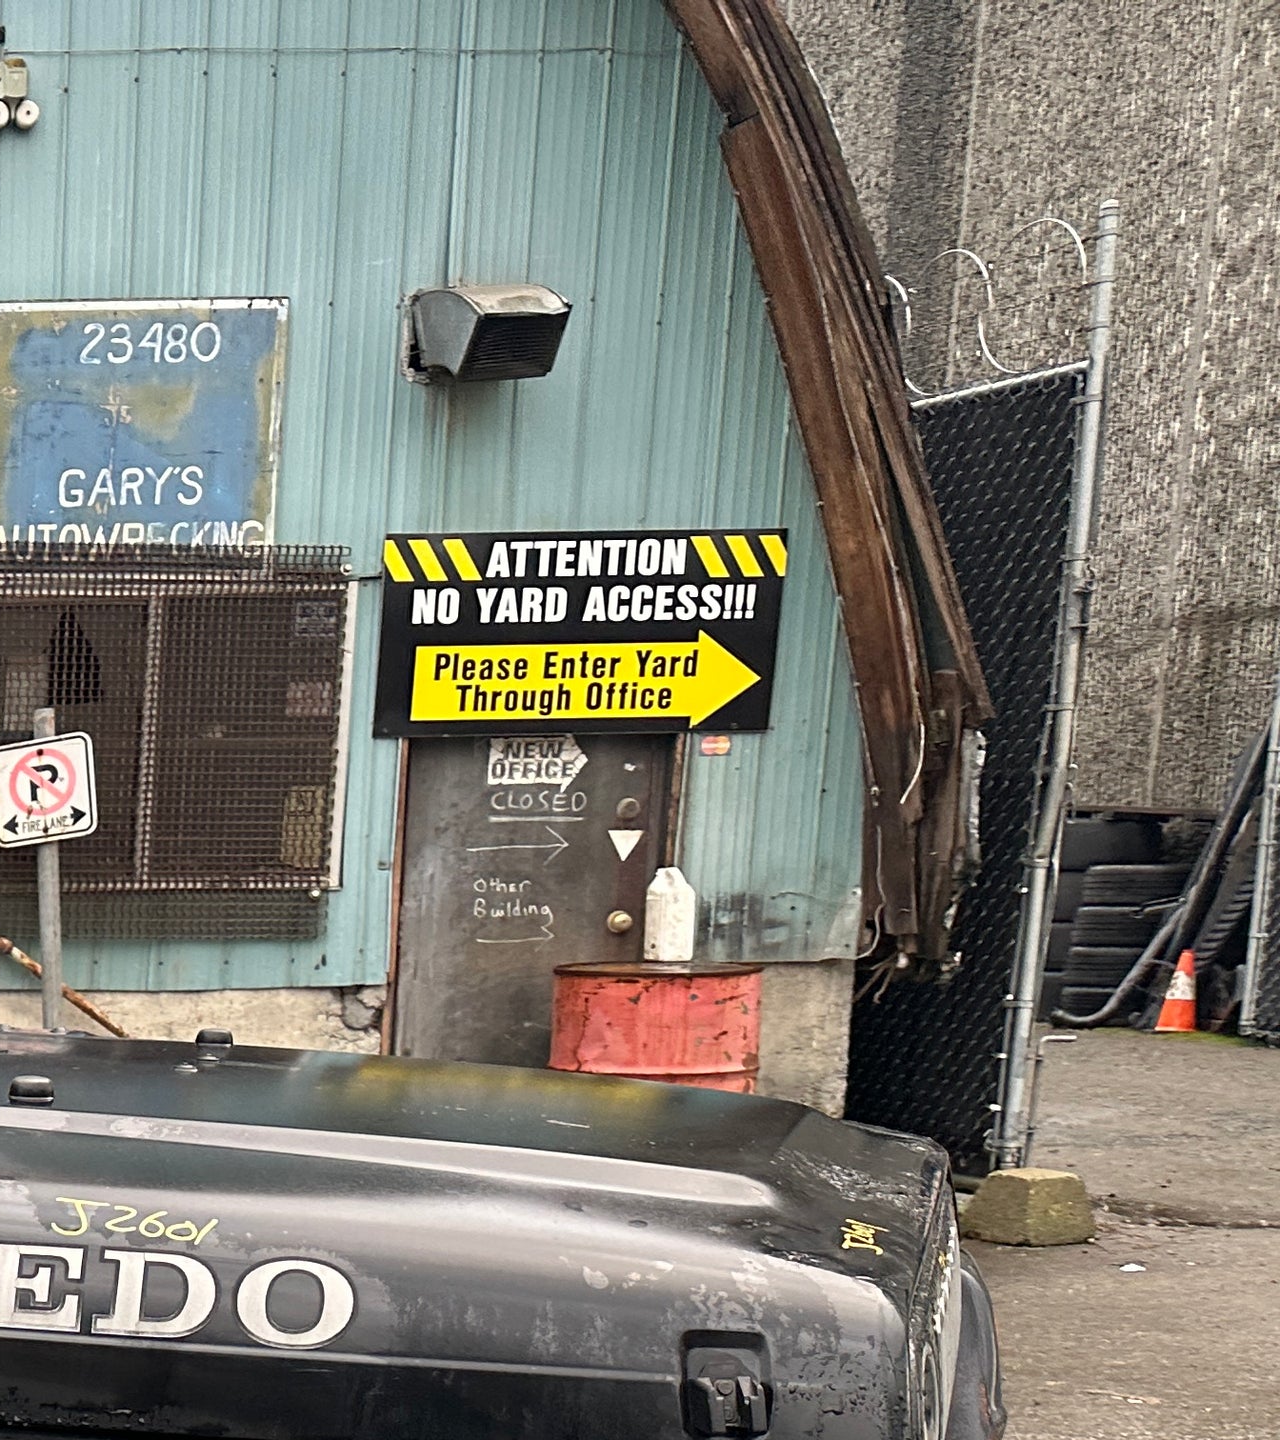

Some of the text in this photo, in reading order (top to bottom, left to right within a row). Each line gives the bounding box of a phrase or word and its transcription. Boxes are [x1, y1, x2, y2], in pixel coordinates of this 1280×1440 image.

[79, 322, 221, 364] 23480
[58, 466, 204, 508] GARY'S
[485, 538, 688, 578] ATTENTION
[411, 584, 757, 625] NO YARD ACCESS!!!
[433, 650, 699, 682] Please Enter Yard
[456, 682, 673, 715] Through Office
[505, 740, 562, 759] NEW
[492, 759, 574, 779] OFFICE
[491, 790, 587, 812] CLOSED
[22, 819, 41, 833] FIRE
[473, 898, 554, 924] Building
[51, 1196, 221, 1247] J2601
